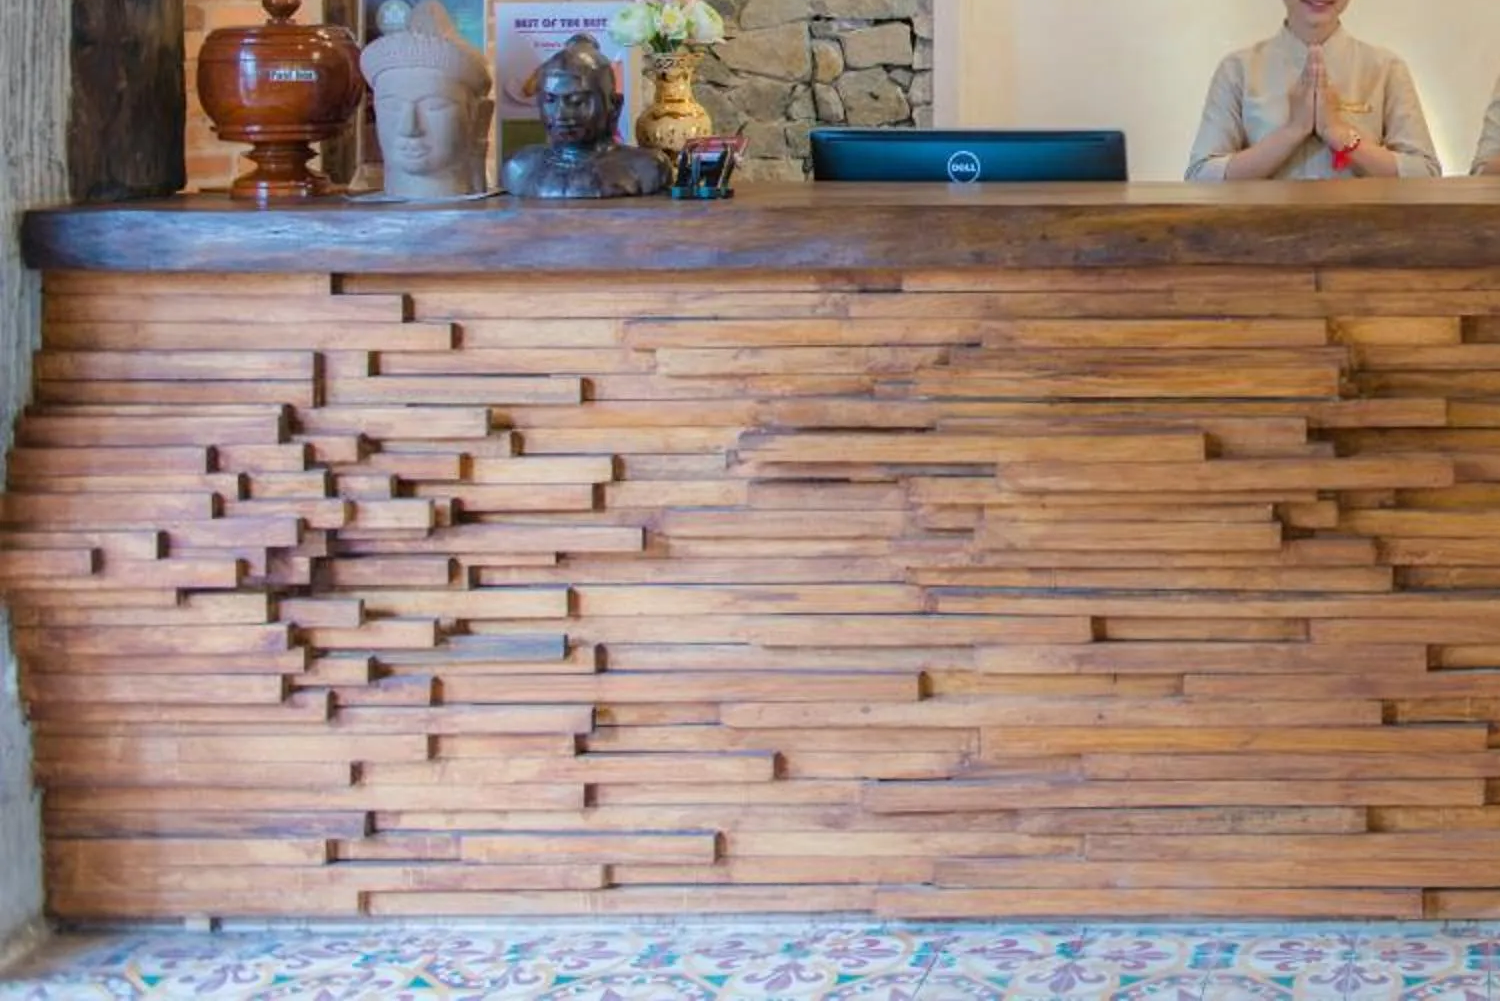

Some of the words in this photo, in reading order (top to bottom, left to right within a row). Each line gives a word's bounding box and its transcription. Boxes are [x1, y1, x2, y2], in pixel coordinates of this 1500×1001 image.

[514, 17, 540, 29] BEST
[541, 17, 558, 29] OF
[559, 17, 581, 29] THE
[582, 17, 608, 29] BEST
[951, 162, 977, 172] DELL
